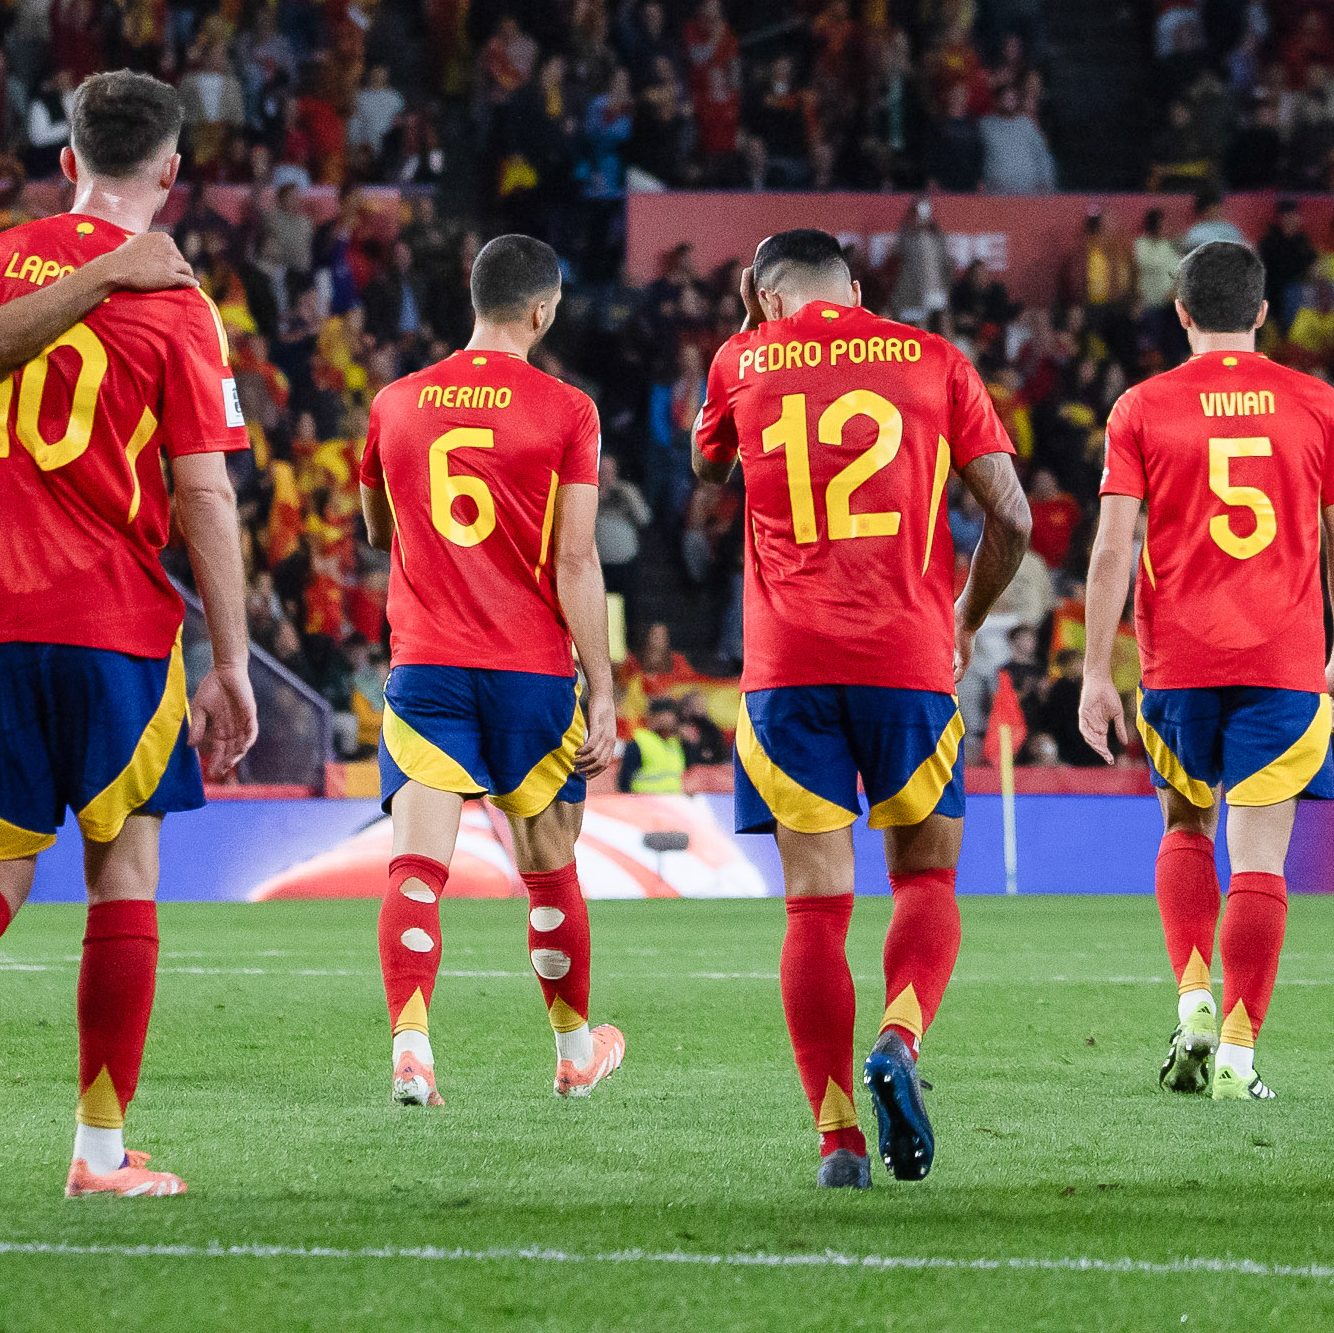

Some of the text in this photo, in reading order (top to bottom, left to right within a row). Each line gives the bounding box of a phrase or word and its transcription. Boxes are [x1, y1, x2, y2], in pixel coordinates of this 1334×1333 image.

[417, 385, 512, 410] MERINO
[737, 336, 922, 381] PEDRO PORRO
[1199, 390, 1276, 417] VIVIAN
[428, 427, 497, 547] 6
[762, 389, 904, 545] 12
[1208, 436, 1278, 560] 5
